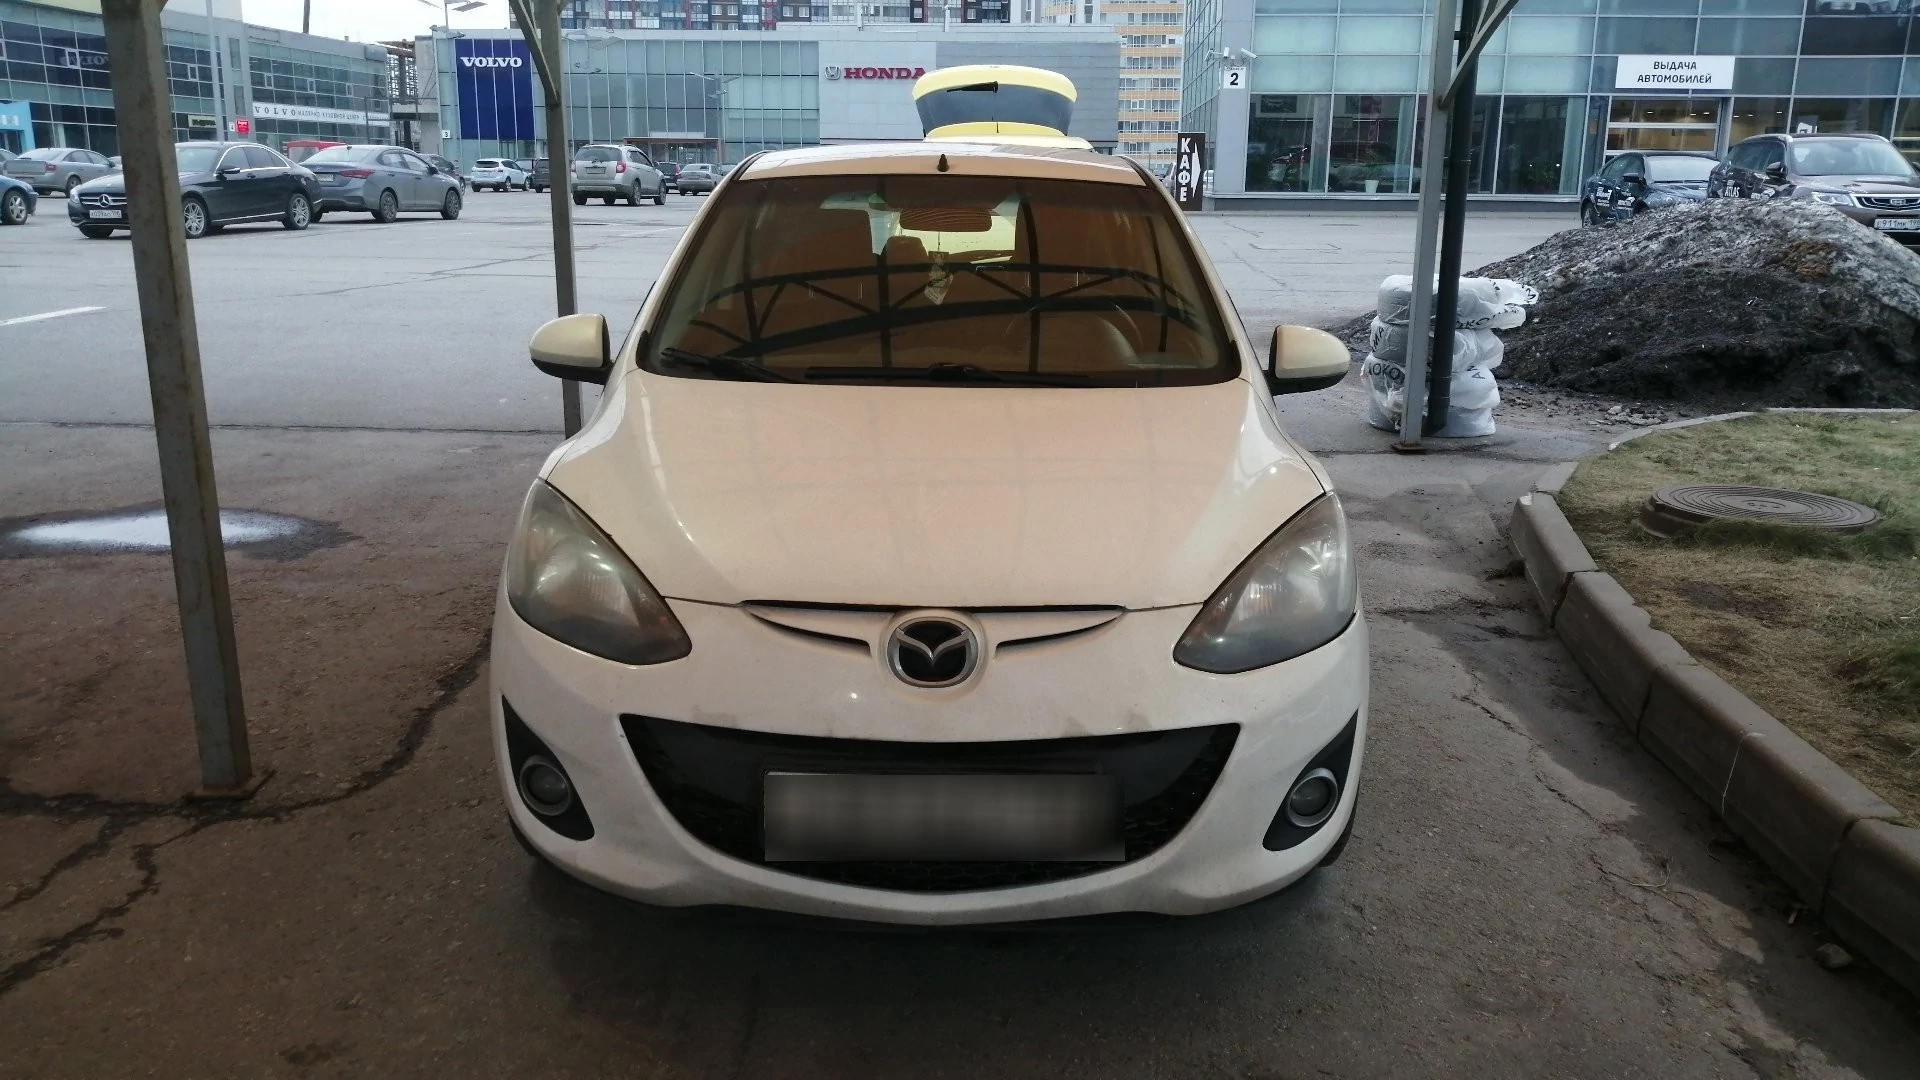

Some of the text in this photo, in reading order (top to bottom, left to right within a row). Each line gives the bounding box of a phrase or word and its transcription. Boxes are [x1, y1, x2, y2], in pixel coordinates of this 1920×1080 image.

[460, 57, 523, 68] VOLVO
[1653, 62, 1697, 70] ВЫДАЧА
[844, 67, 926, 79] HONDA
[1637, 73, 1712, 83] АВТОМОБИЛЕЙ
[1230, 73, 1239, 85] 2
[254, 106, 296, 116] VOLVO
[1178, 138, 1191, 202] КАФЕ
[1724, 186, 1740, 197] ATLAS
